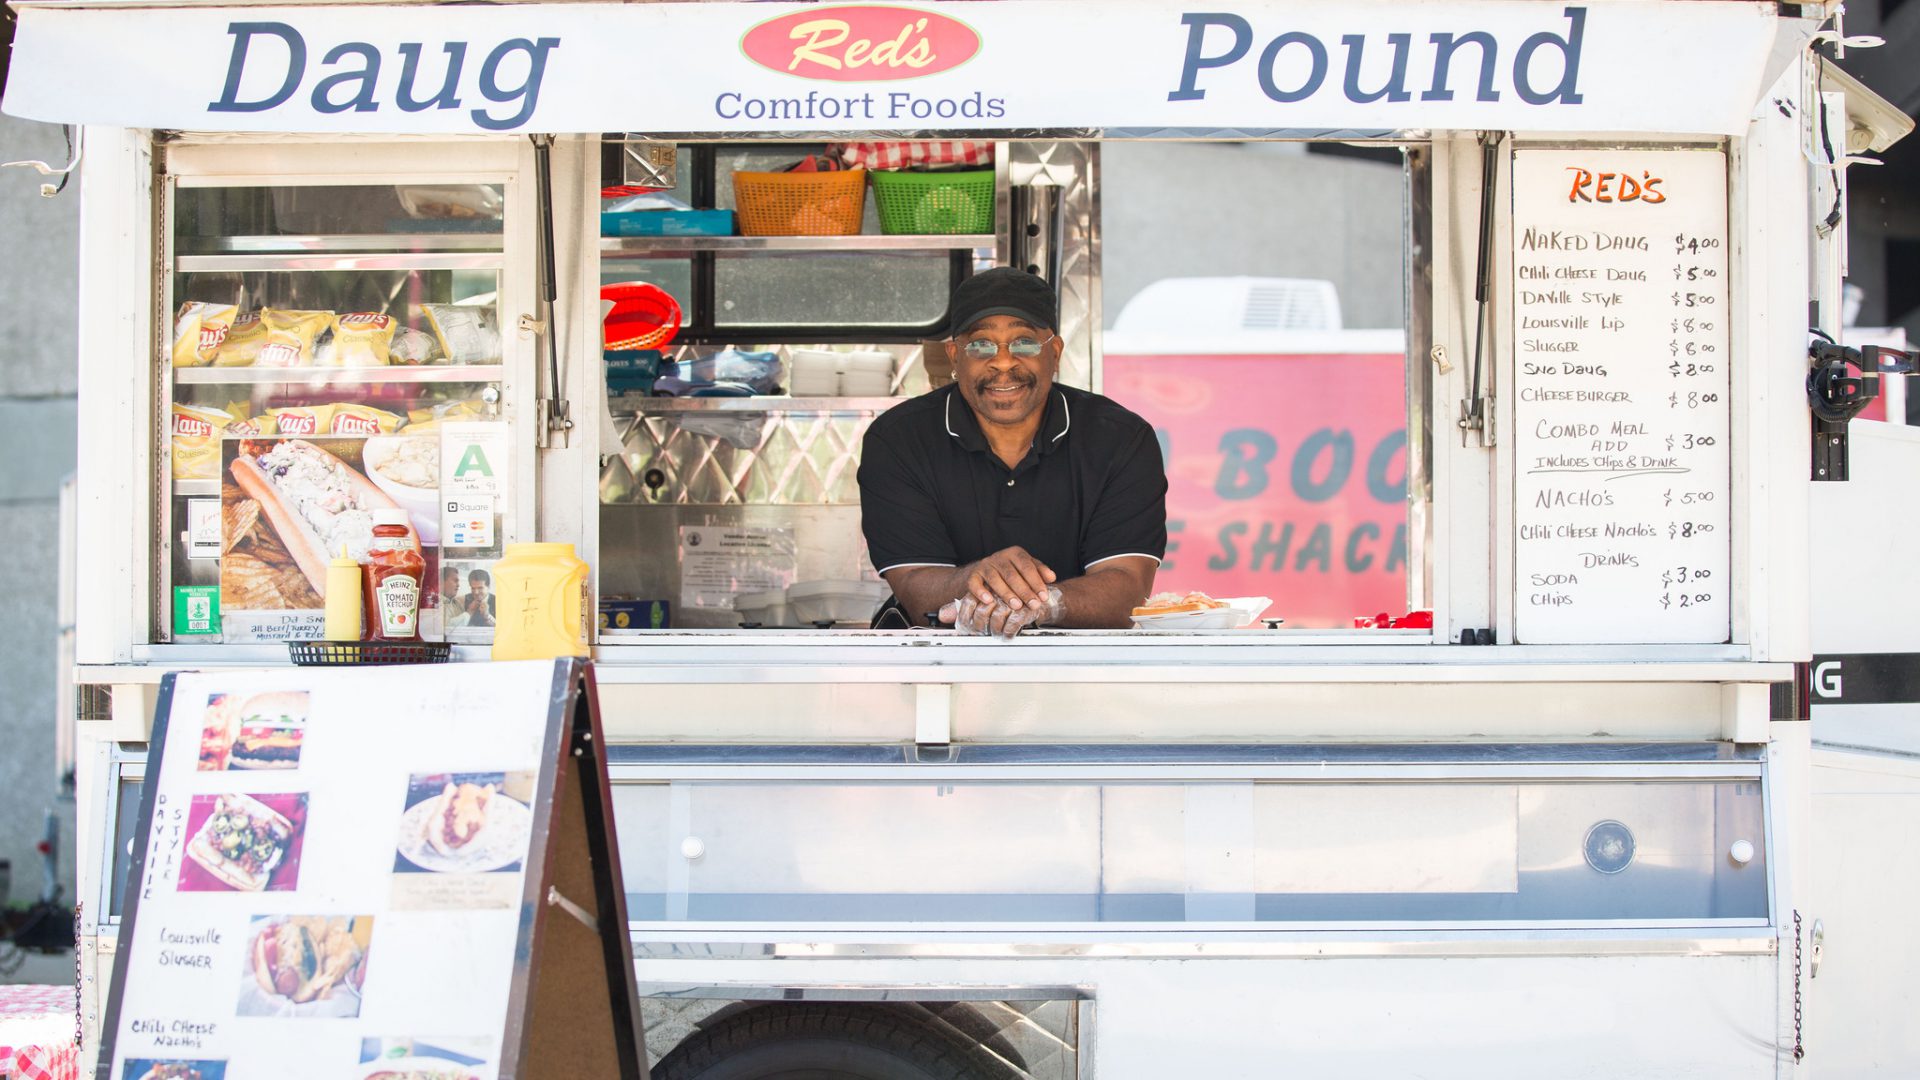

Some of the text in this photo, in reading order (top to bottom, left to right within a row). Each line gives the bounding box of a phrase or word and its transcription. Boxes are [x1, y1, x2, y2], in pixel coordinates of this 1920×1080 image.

[788, 17, 937, 71] Red's
[1167, 7, 1588, 105] Pound
[207, 22, 561, 131] Daug
[715, 91, 1006, 119] Comfort Foods
[1565, 167, 1666, 204] RED'S
[1521, 227, 1588, 251] NAKED
[1535, 419, 1649, 440] COMBO MEAL
[1591, 440, 1628, 452] ADD
[454, 445, 494, 477] A
[1626, 455, 1637, 468] &
[460, 502, 489, 512] Square
[390, 580, 411, 590] HEINZ
[1531, 573, 1578, 586] SODA
[385, 593, 414, 602] TOMATO
